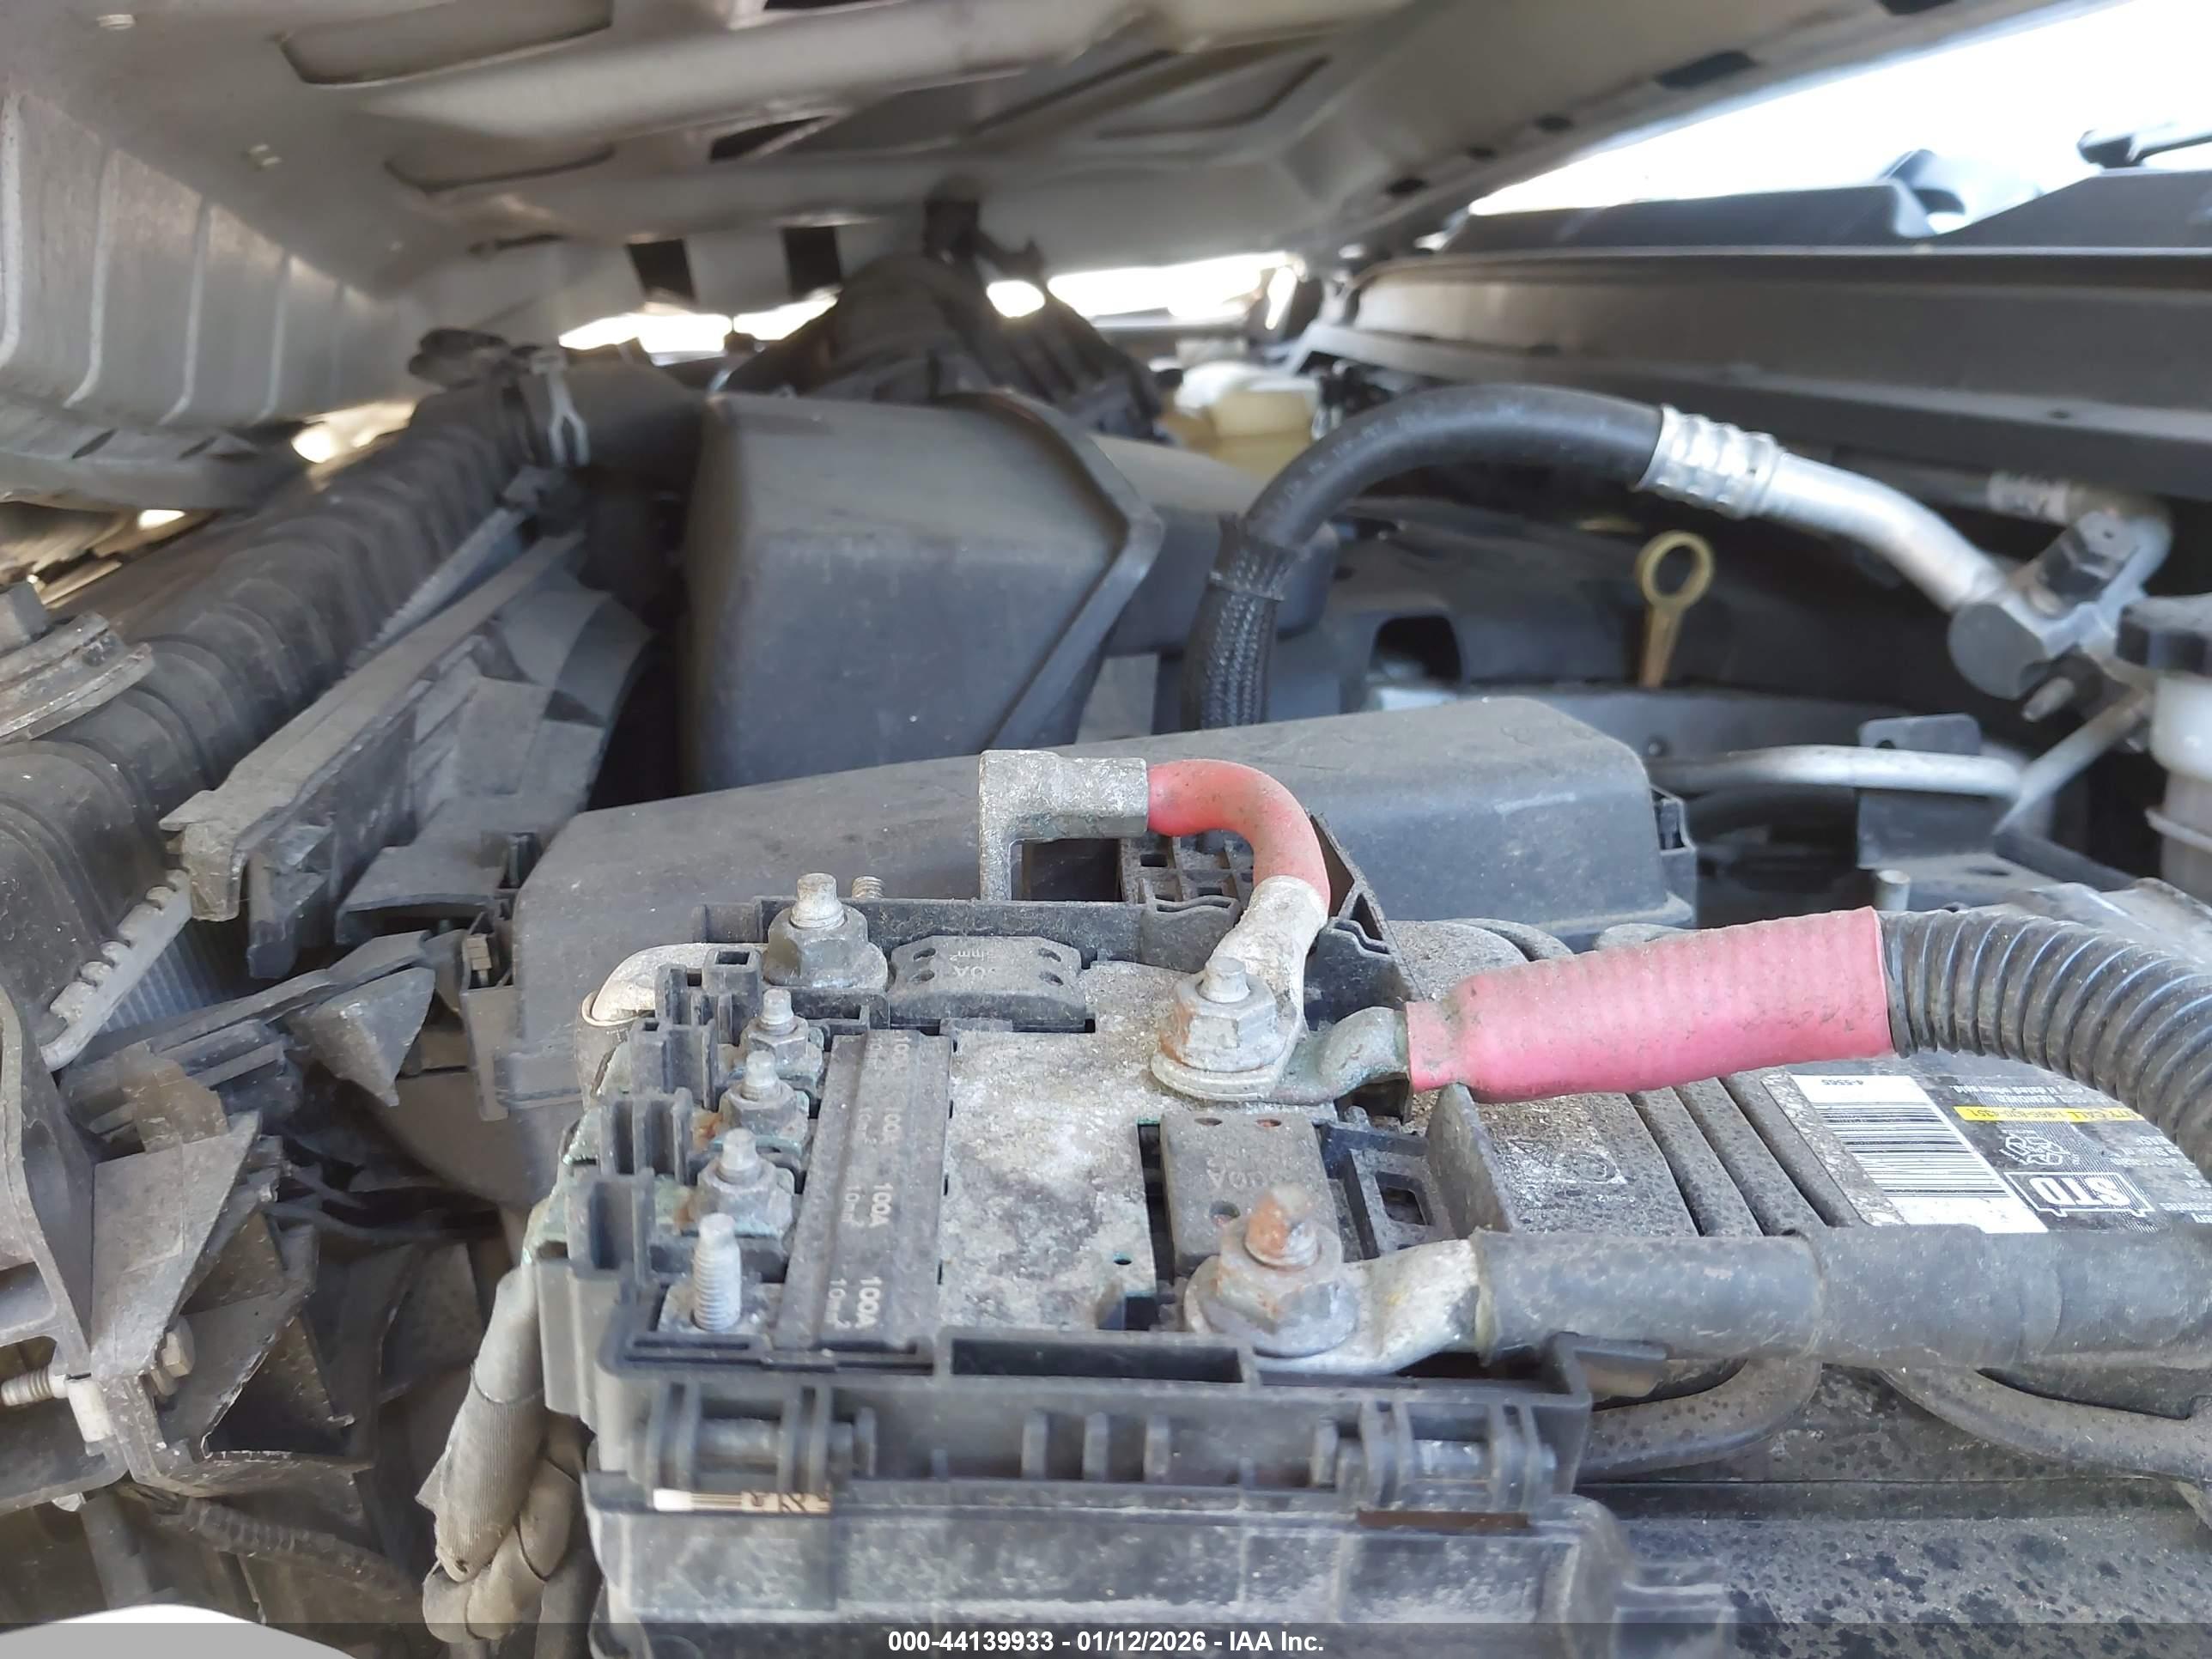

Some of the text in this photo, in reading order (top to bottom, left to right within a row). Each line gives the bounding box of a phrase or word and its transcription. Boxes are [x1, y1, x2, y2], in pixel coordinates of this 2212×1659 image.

[868, 1182, 895, 1229] 100A
[2028, 1176, 2131, 1206] STD
[854, 1275, 884, 1329] 100A
